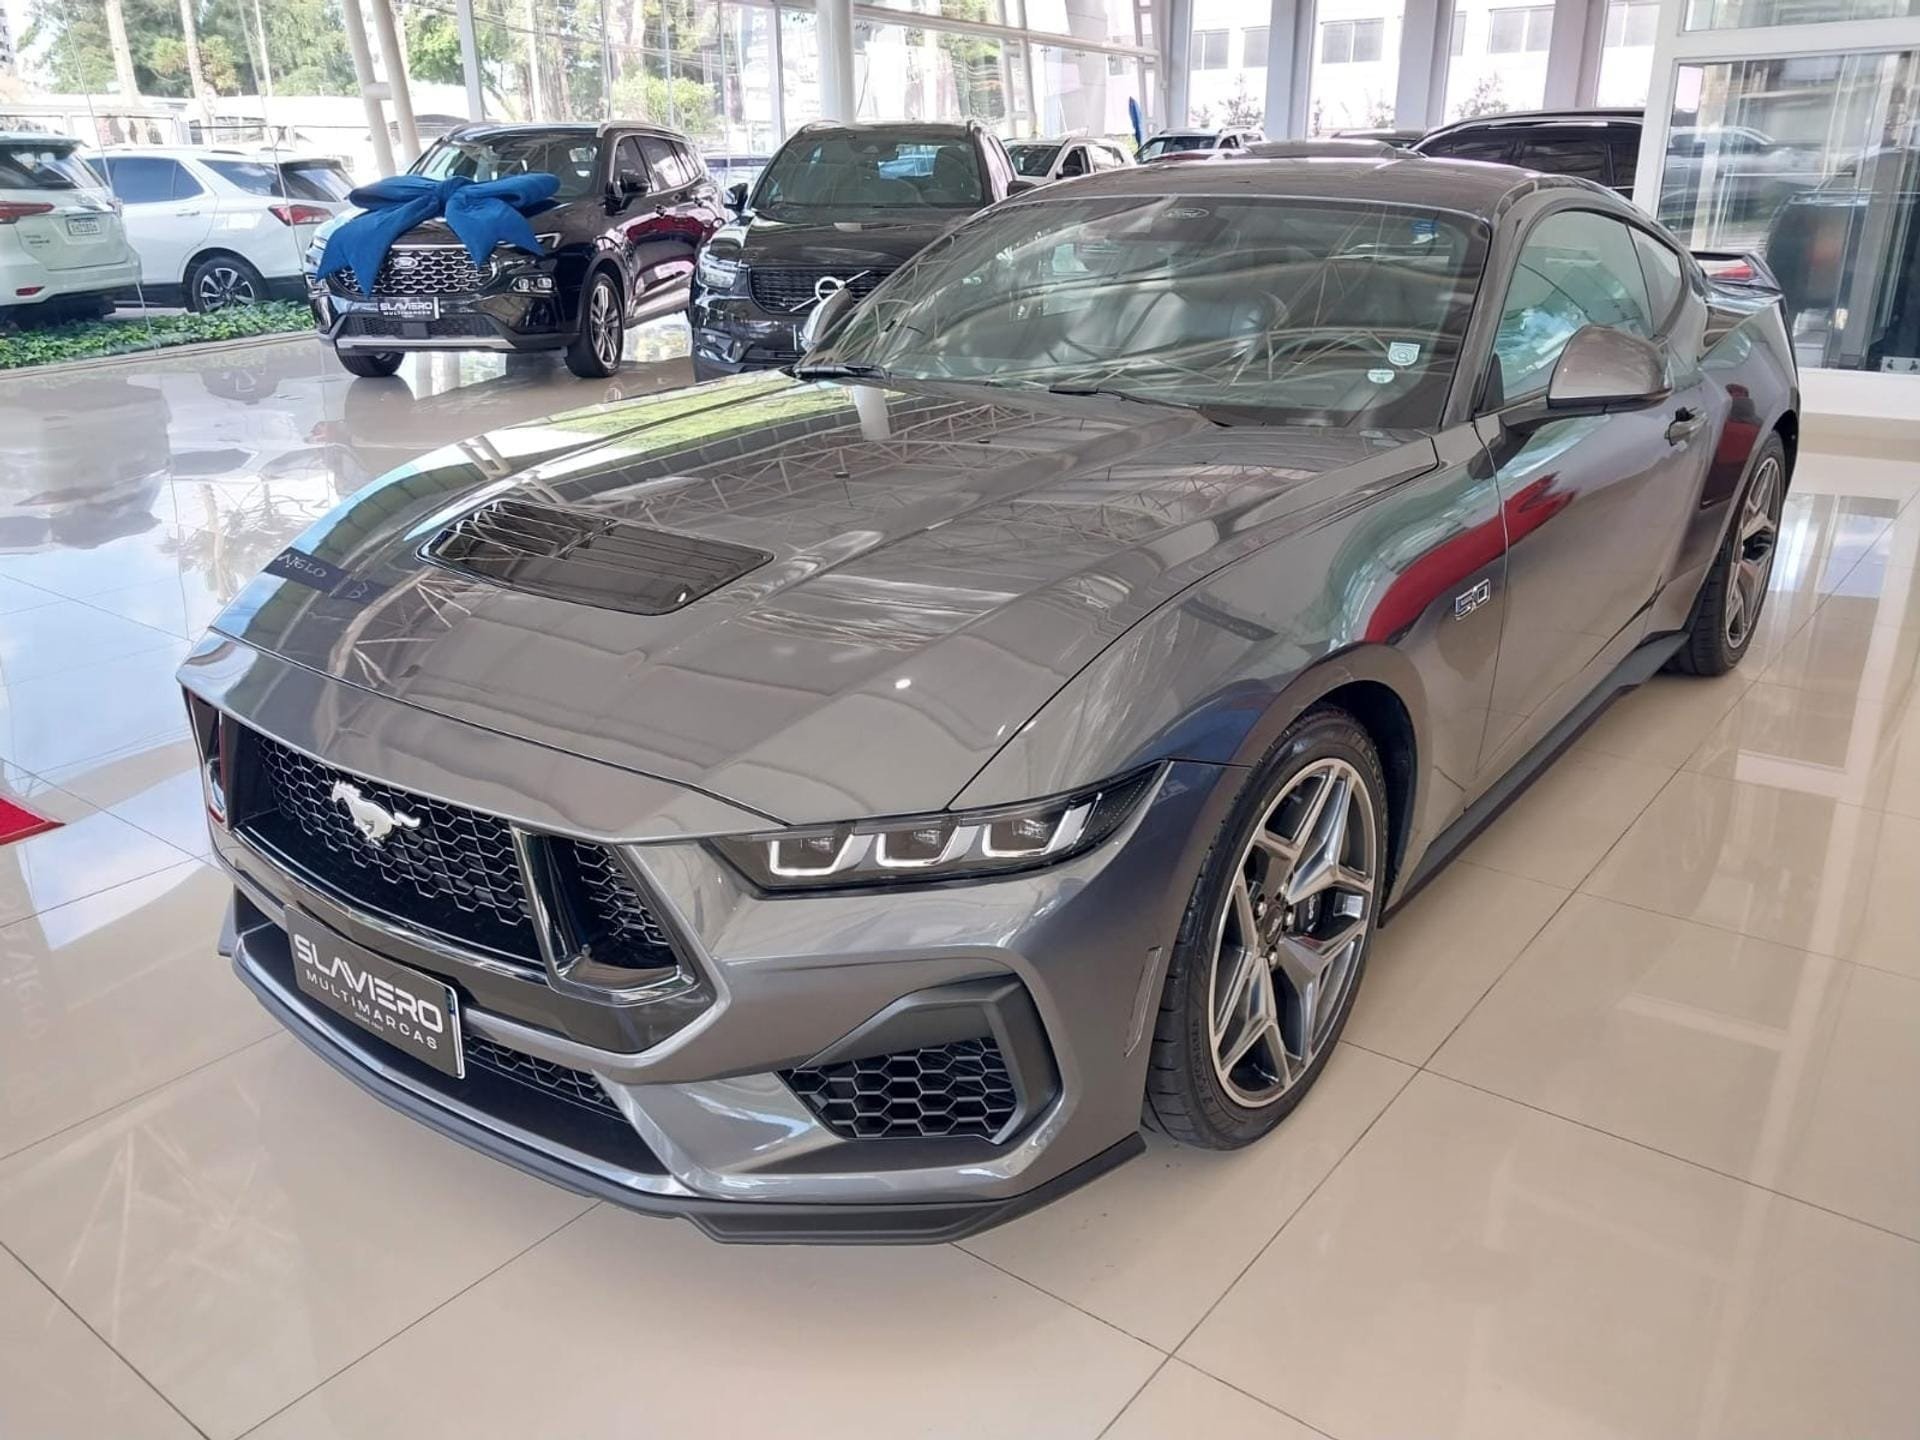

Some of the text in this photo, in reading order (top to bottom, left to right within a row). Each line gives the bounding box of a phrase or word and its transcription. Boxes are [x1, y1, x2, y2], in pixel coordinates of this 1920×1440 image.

[380, 302, 432, 311] SLAVIERO
[294, 934, 443, 1033] SLAVIERO
[306, 970, 438, 1049] MULTIMARCAS
